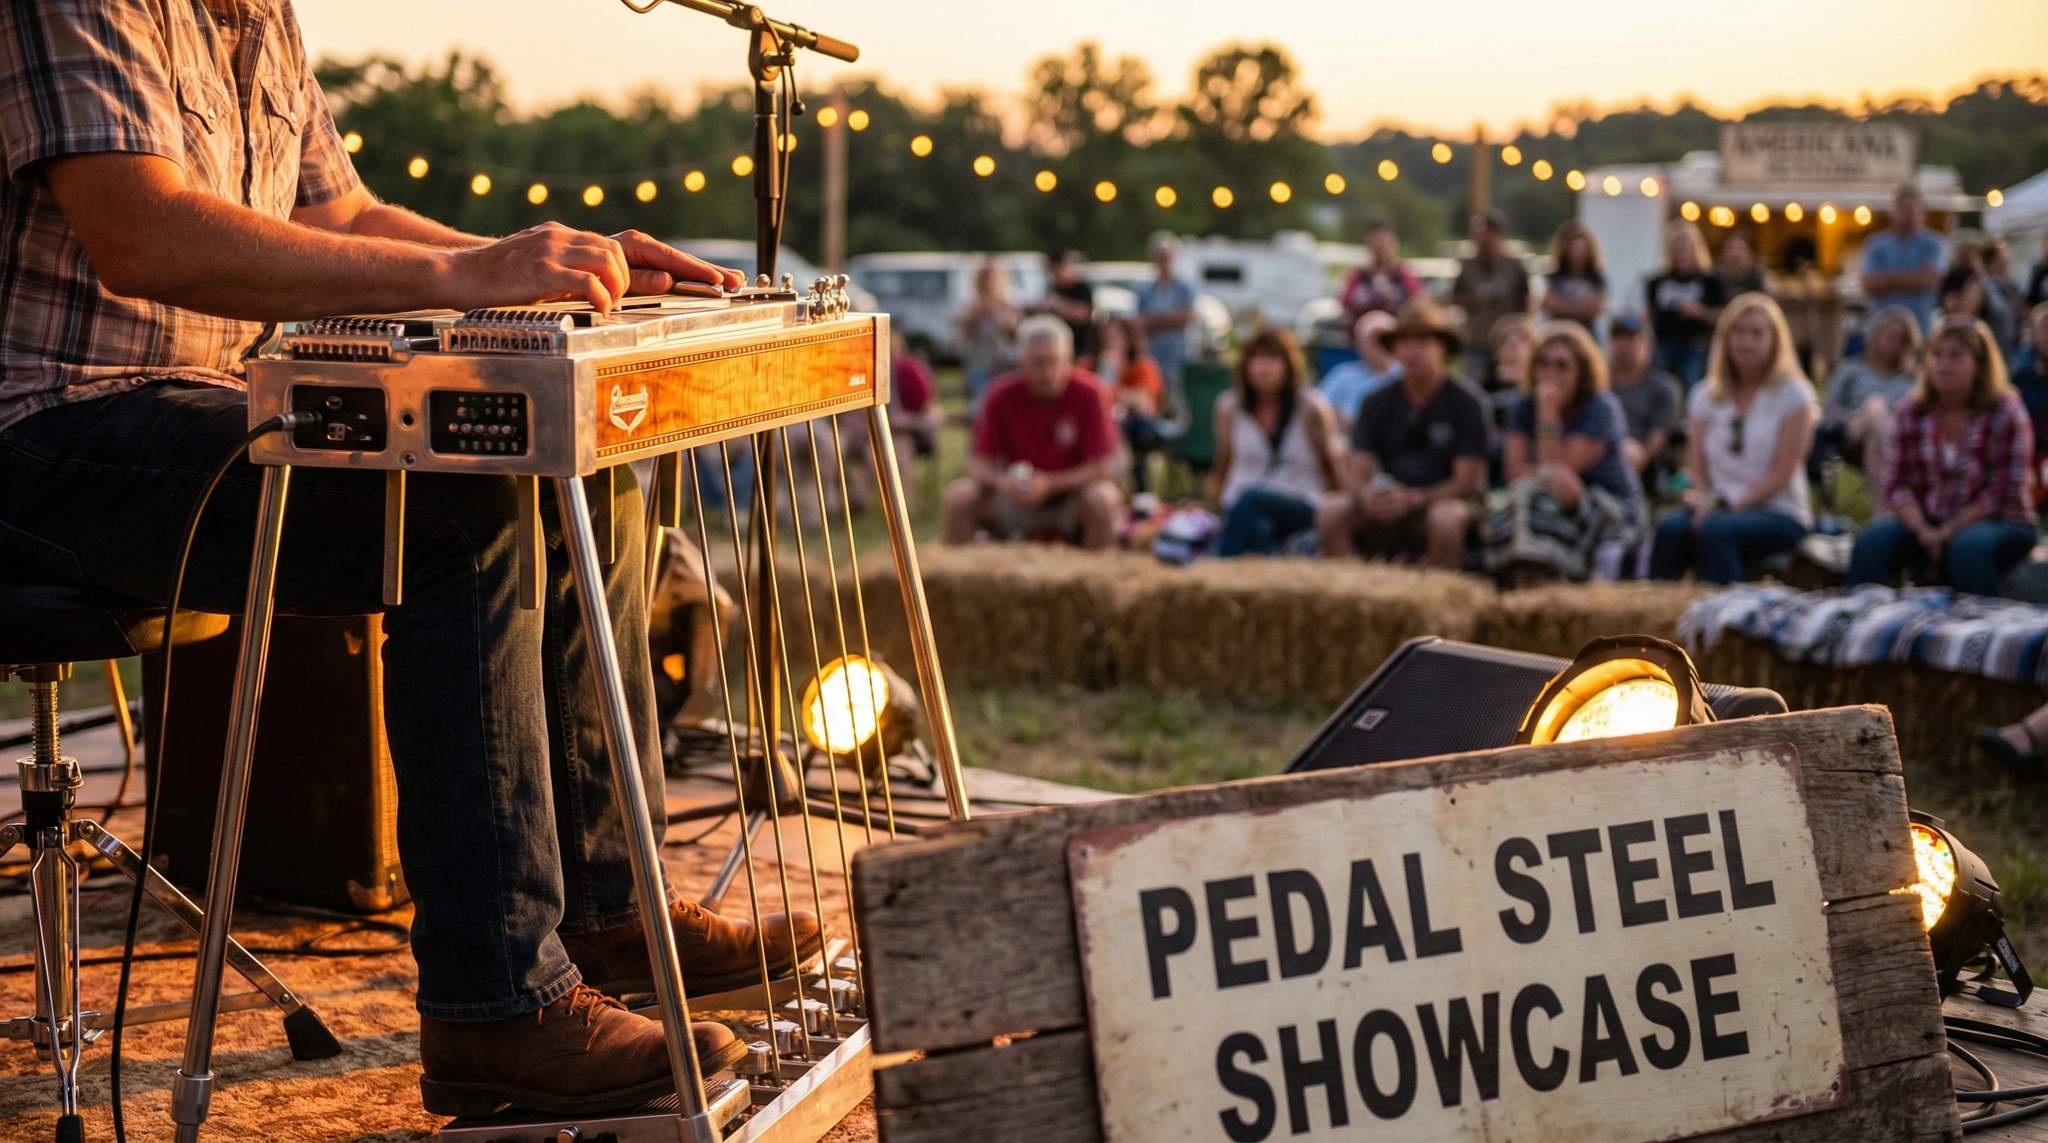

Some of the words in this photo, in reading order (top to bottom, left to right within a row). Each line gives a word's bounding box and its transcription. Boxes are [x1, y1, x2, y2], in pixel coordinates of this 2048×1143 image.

[1139, 852, 1463, 999] PEDAL
[1495, 809, 1777, 945] STEEL
[1215, 953, 1751, 1143] SHOWCASE
